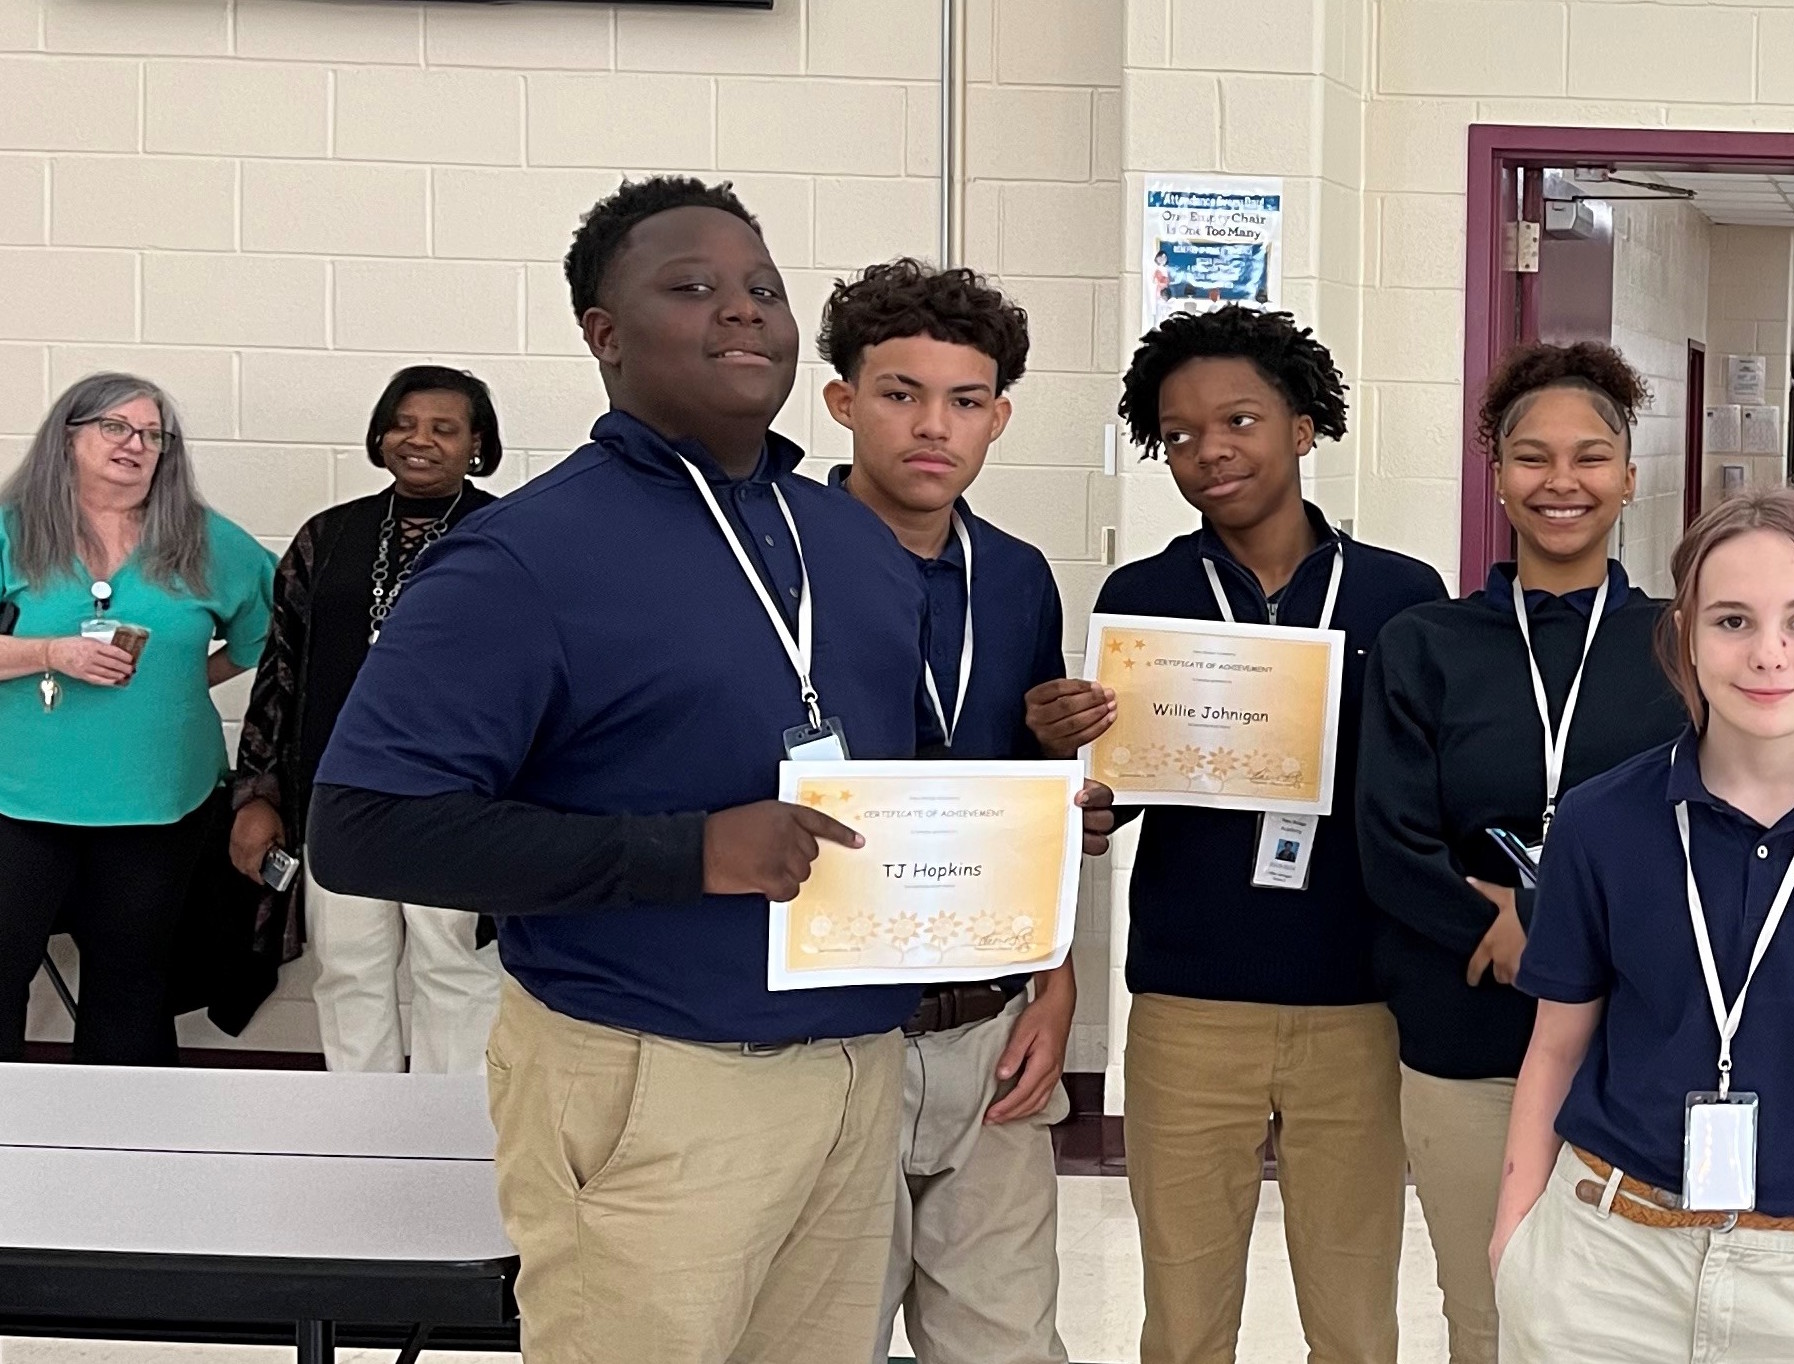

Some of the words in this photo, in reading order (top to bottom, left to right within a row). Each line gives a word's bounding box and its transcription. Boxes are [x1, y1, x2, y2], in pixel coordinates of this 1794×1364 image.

[1162, 211, 1186, 221] On
[1231, 213, 1266, 225] Chair
[1205, 225, 1226, 236] Too
[1227, 226, 1261, 241] Many
[1153, 702, 1196, 718] Willie
[1201, 706, 1269, 725] Johnigan
[864, 810, 923, 819] CERTIFICATE
[926, 809, 938, 818] OF
[941, 808, 1005, 818] ACHIEVEMENT
[882, 863, 907, 879] TJ
[913, 862, 982, 881] Hopkins
